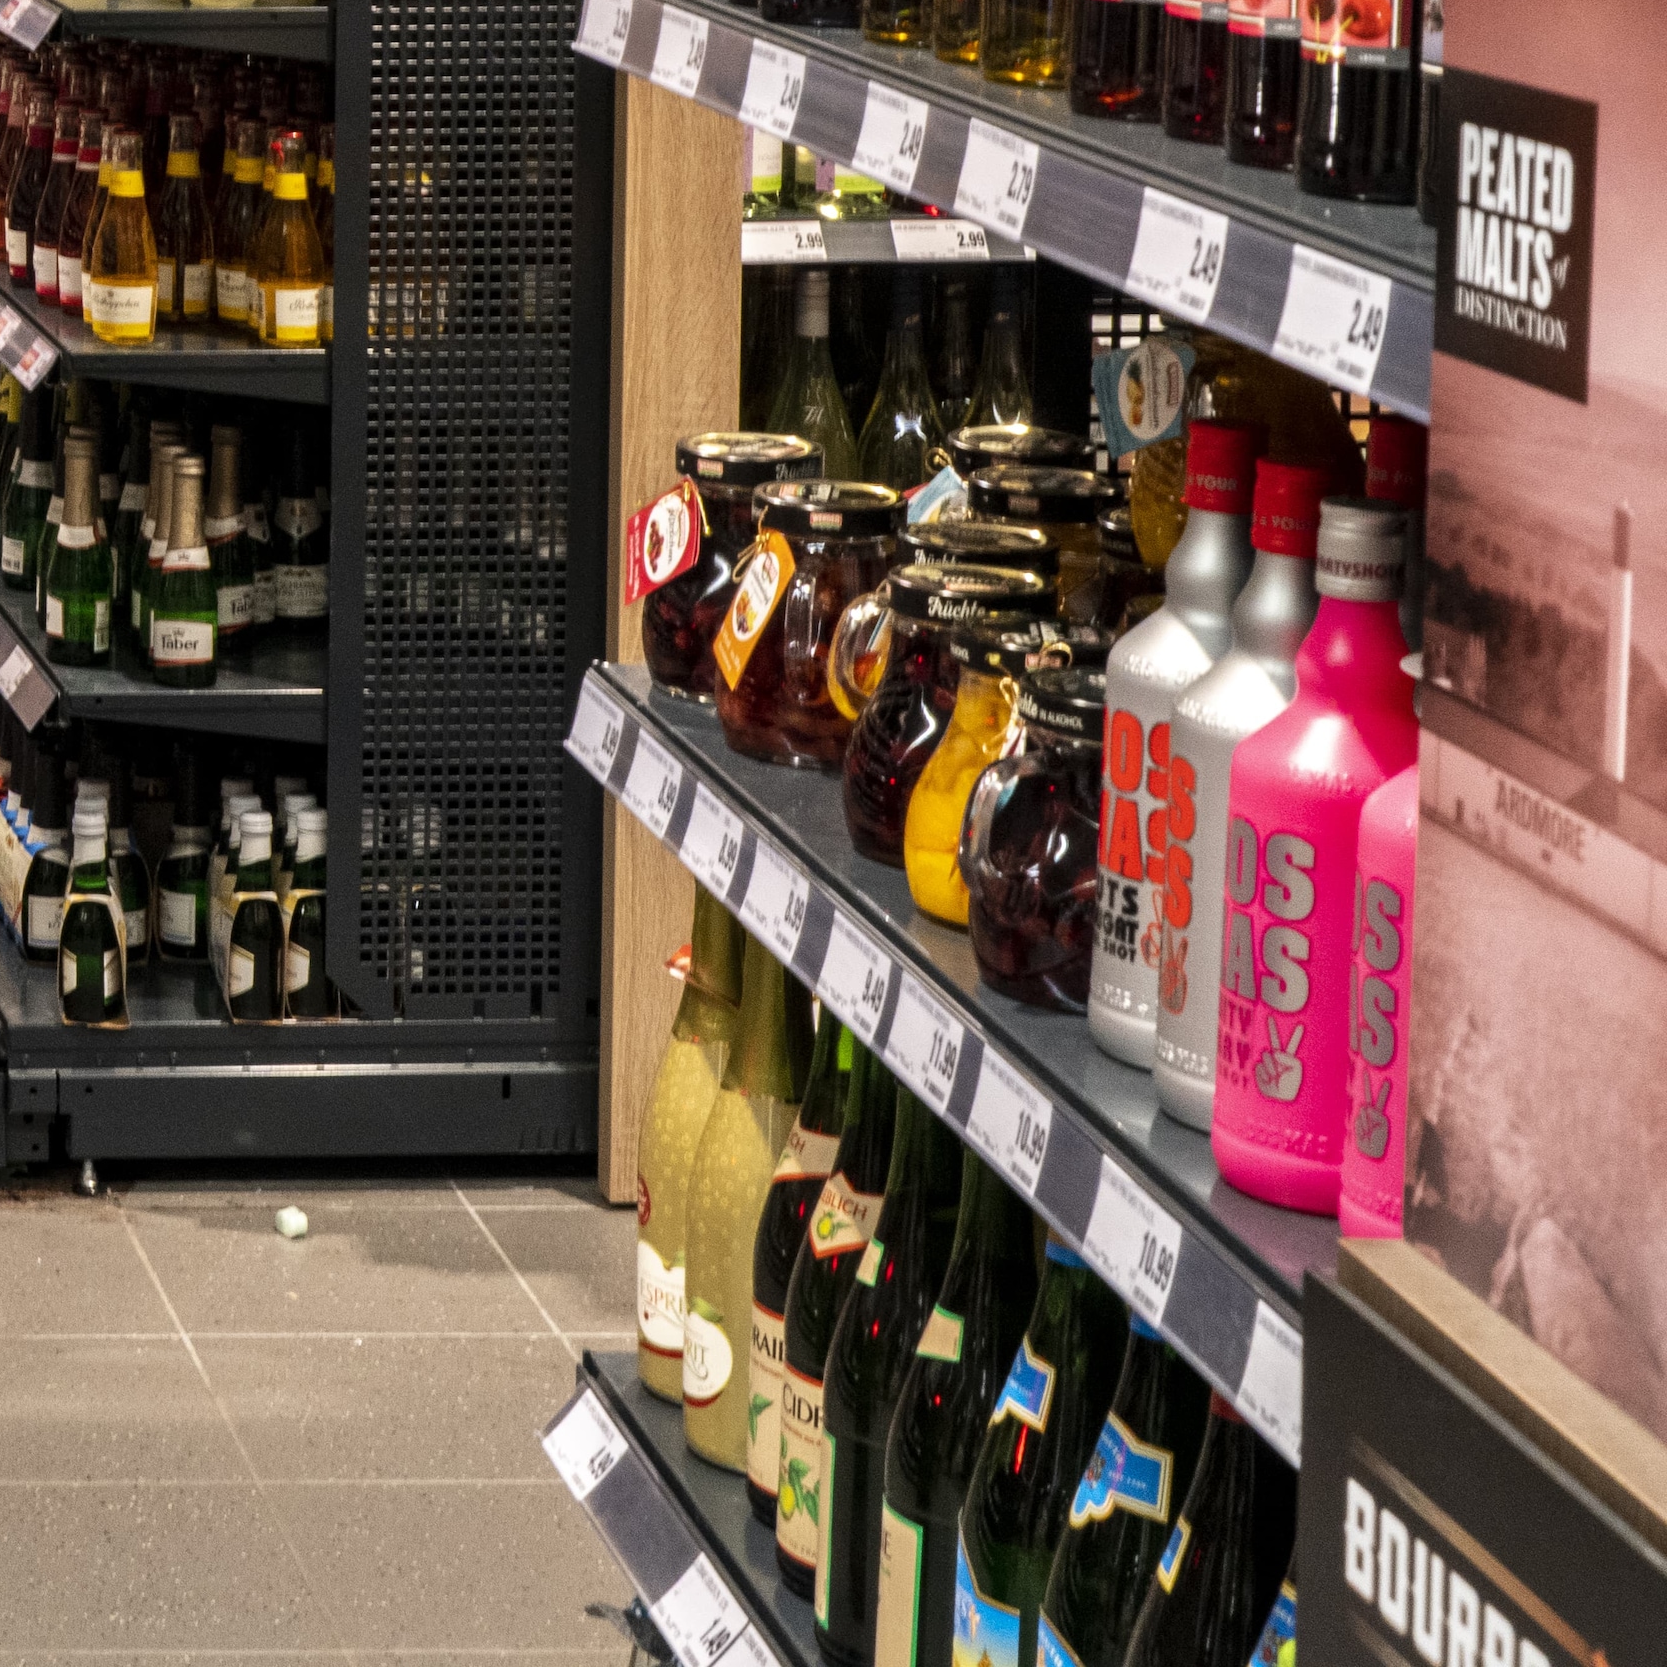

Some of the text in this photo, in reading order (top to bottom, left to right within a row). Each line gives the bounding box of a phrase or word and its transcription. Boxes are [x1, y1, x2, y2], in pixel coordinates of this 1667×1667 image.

[898, 122, 923, 162] 2.49
[1006, 161, 1033, 206] 2.79
[1459, 121, 1574, 236] PEATED
[795, 232, 824, 249] 2.99
[957, 232, 986, 248] 2.99
[1189, 236, 1221, 284] 2.49
[1455, 204, 1554, 311] MALTS
[1348, 298, 1383, 353] 2.49
[1454, 281, 1568, 354] DISTINCTION
[927, 595, 986, 620] Früchte
[927, 1029, 958, 1082] 11.99
[1016, 1110, 1046, 1167] 10.99
[1138, 1230, 1173, 1292] 10.99
[1344, 1477, 1554, 1667] BOURB
